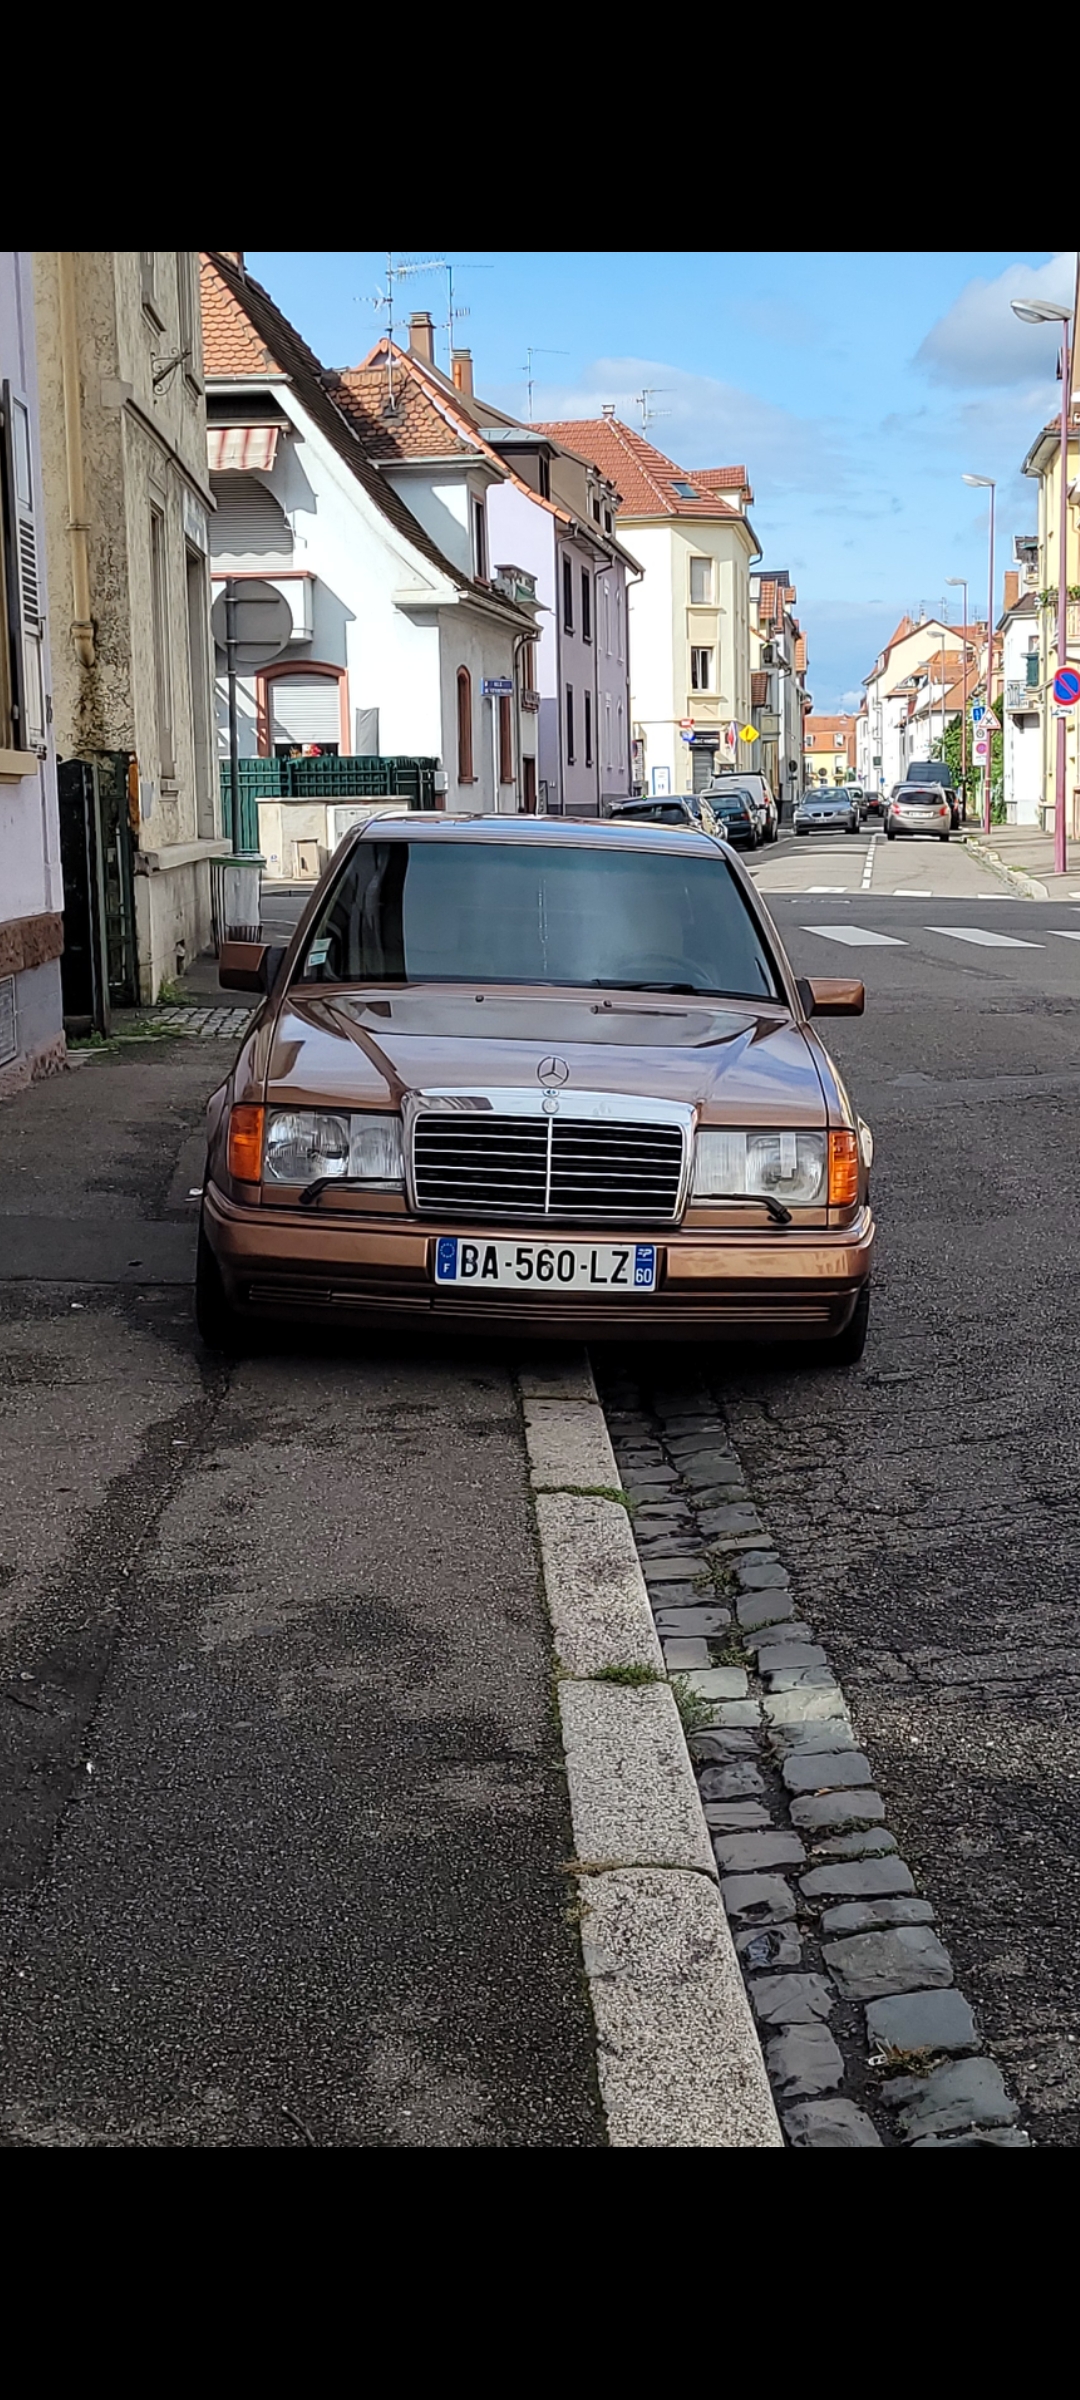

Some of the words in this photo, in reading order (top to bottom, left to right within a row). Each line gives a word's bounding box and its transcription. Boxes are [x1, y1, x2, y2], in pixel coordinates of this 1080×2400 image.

[442, 1263, 450, 1273] F
[460, 1244, 630, 1284] BA-560-LZ
[635, 1268, 653, 1284] 60
